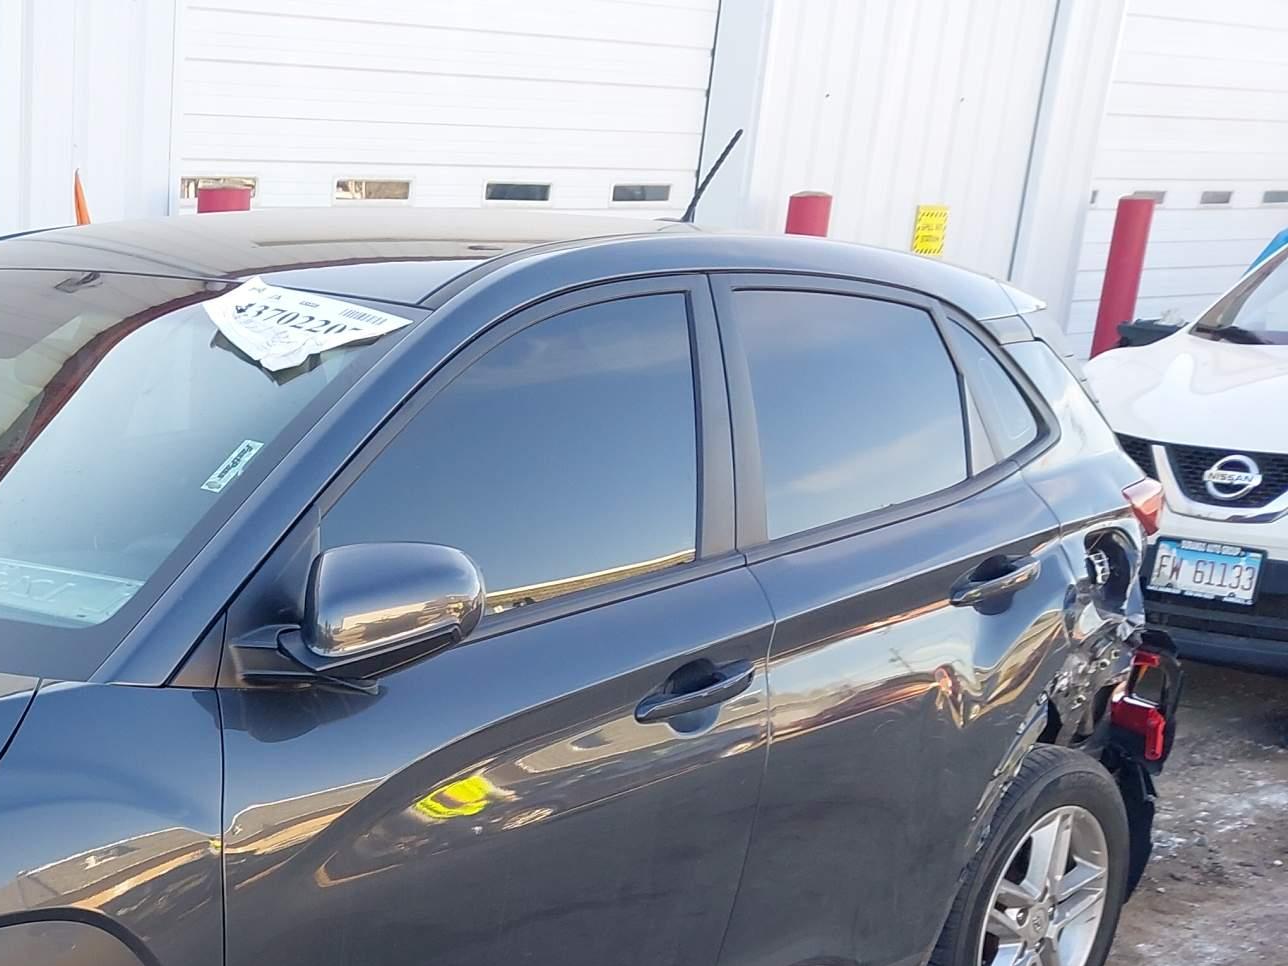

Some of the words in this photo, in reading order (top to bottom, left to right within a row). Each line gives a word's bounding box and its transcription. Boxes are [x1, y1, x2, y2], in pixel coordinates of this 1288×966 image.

[234, 302, 363, 335] 4370220
[1207, 472, 1254, 484] NISSAN
[1156, 554, 1183, 580] FW
[1192, 559, 1256, 591] 61133
